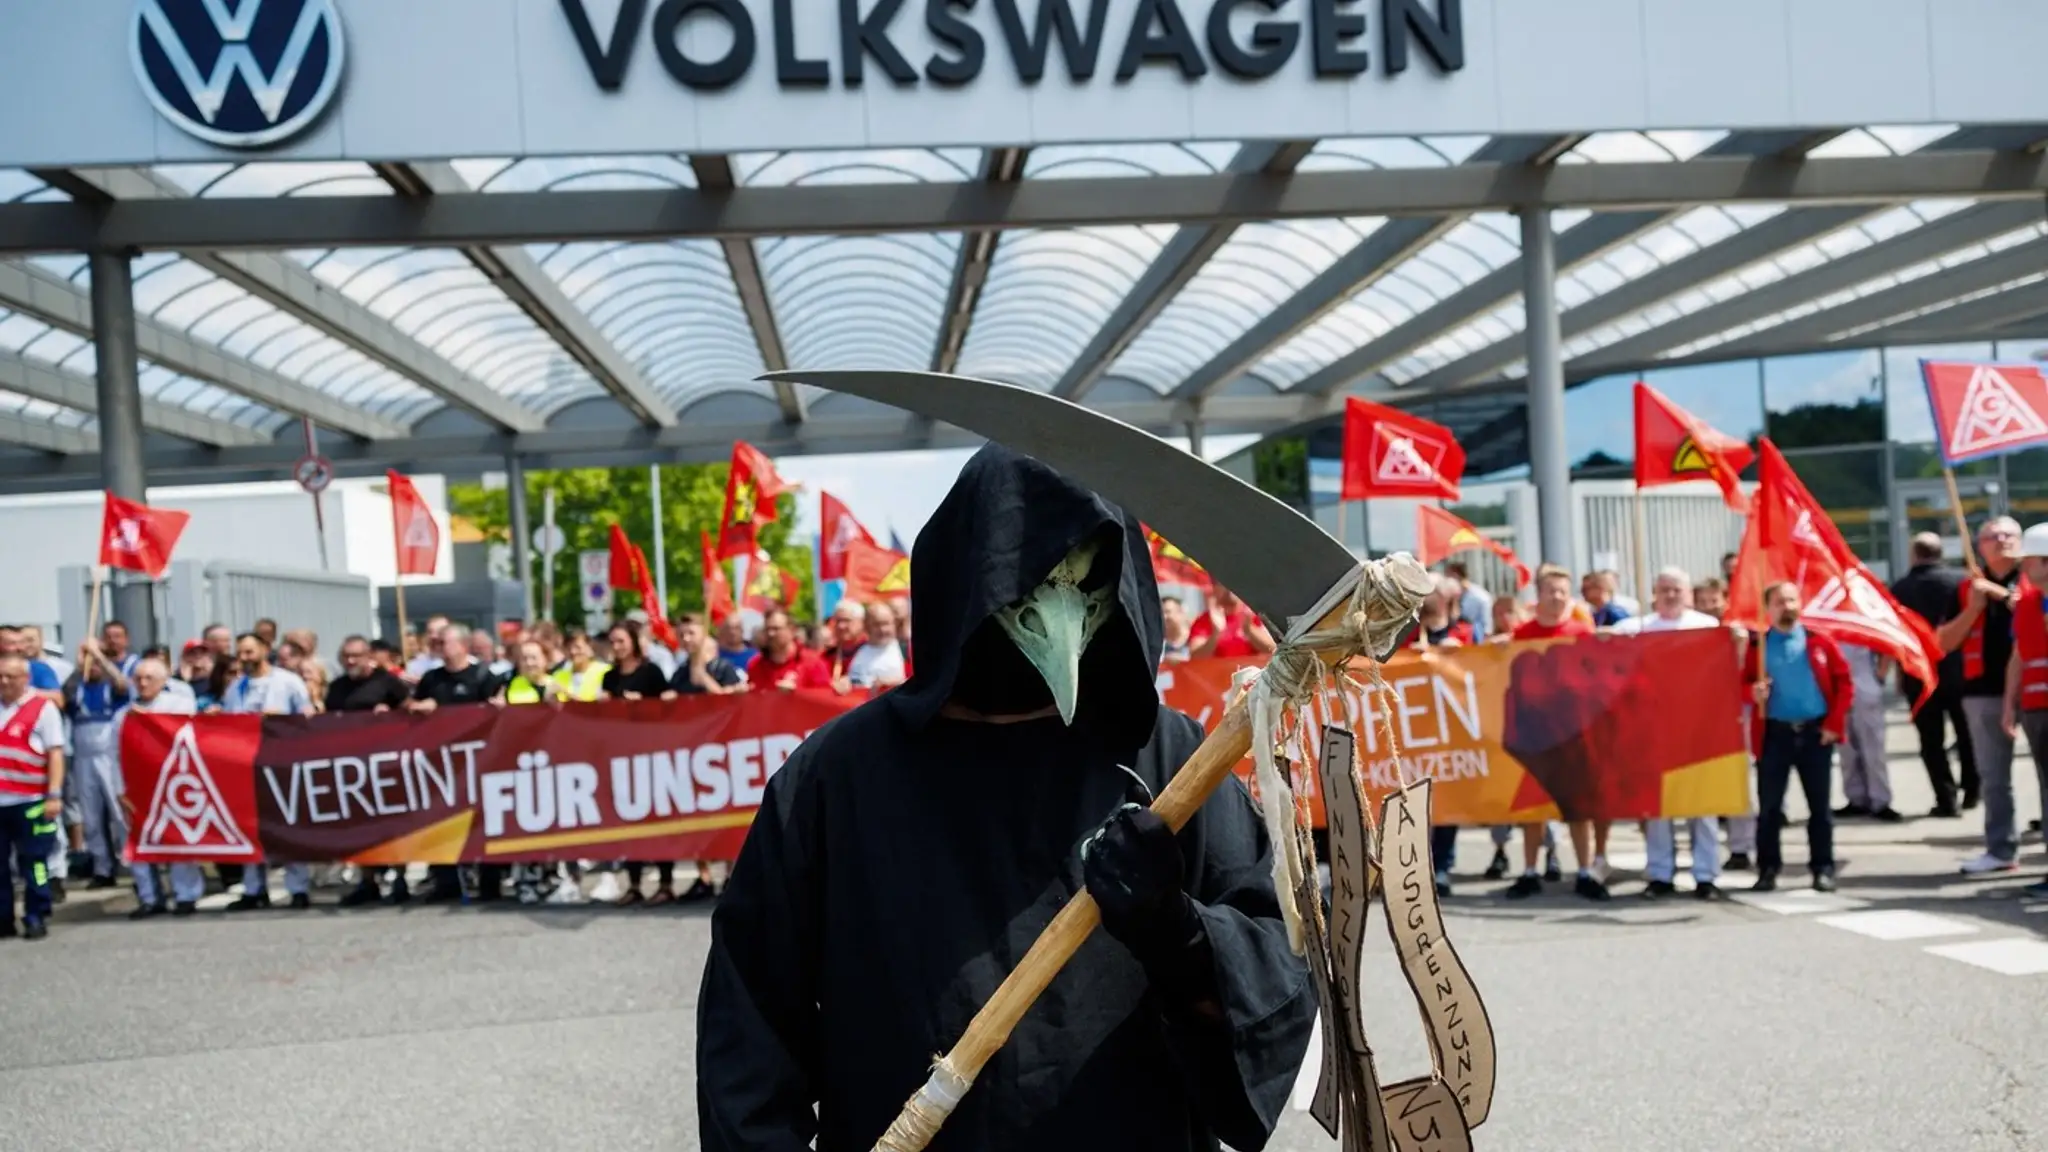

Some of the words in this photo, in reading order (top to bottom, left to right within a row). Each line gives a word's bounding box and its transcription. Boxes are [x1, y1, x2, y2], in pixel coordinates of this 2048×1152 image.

[558, 0, 1464, 92] VOLKSWAGEN
[263, 740, 486, 825] VEREINT
[481, 750, 602, 836] FÜR
[610, 729, 818, 822] UNSE
